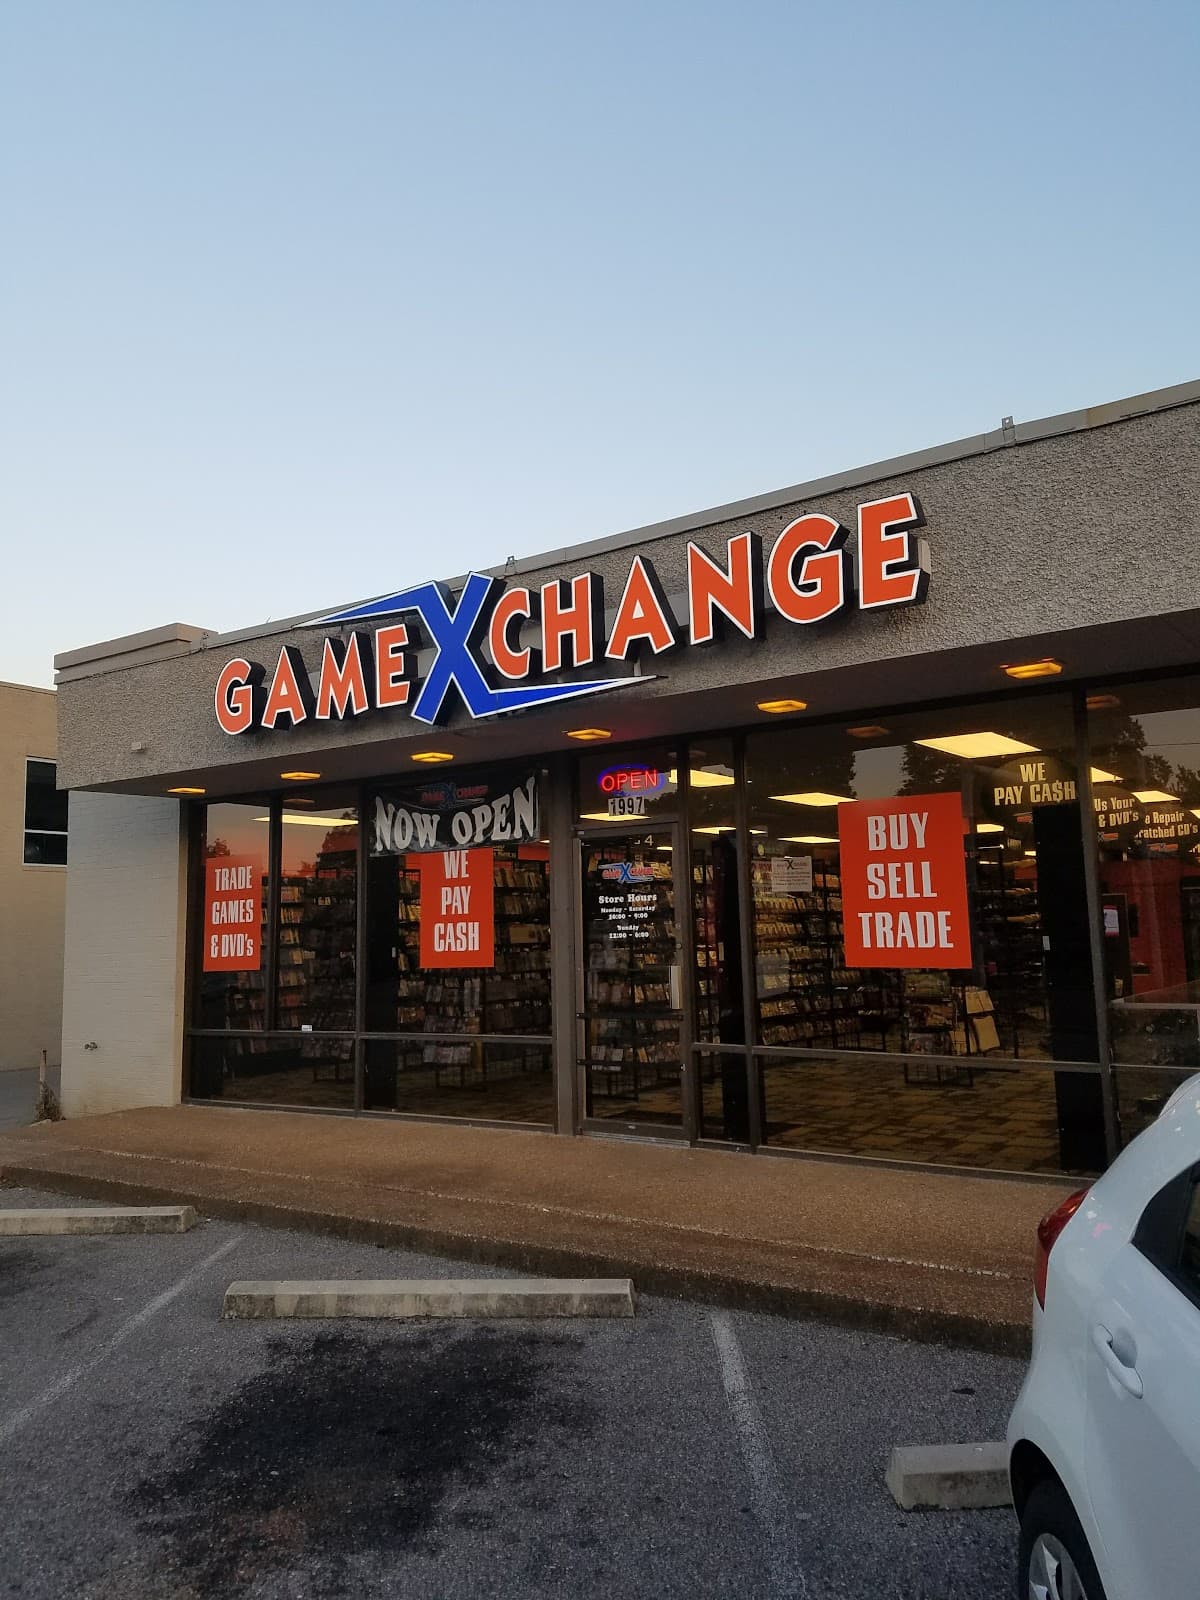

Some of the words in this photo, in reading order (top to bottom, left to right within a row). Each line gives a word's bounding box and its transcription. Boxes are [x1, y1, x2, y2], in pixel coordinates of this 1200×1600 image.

[601, 769, 658, 791] OPEN
[1020, 763, 1047, 782] WE
[610, 796, 643, 816] 1997
[994, 785, 1023, 806] PAY
[1110, 797, 1136, 810] Your
[375, 796, 440, 851] NOW
[452, 776, 536, 845] OPEN
[1109, 811, 1140, 827] DVD's
[1152, 811, 1185, 826] Repair
[867, 812, 929, 851] BUY
[1137, 826, 1175, 839] ratched
[1177, 824, 1198, 836] CD's
[443, 850, 470, 879] WE
[214, 865, 253, 892] TRADE
[866, 861, 938, 899] SELL
[441, 886, 471, 916] PAY
[598, 895, 625, 904] Store
[627, 894, 657, 902] Hours
[212, 899, 254, 925] GAMES
[434, 921, 480, 952] CASH
[857, 911, 954, 948] TRADE
[210, 934, 219, 958] &
[221, 933, 254, 957] DVD's
